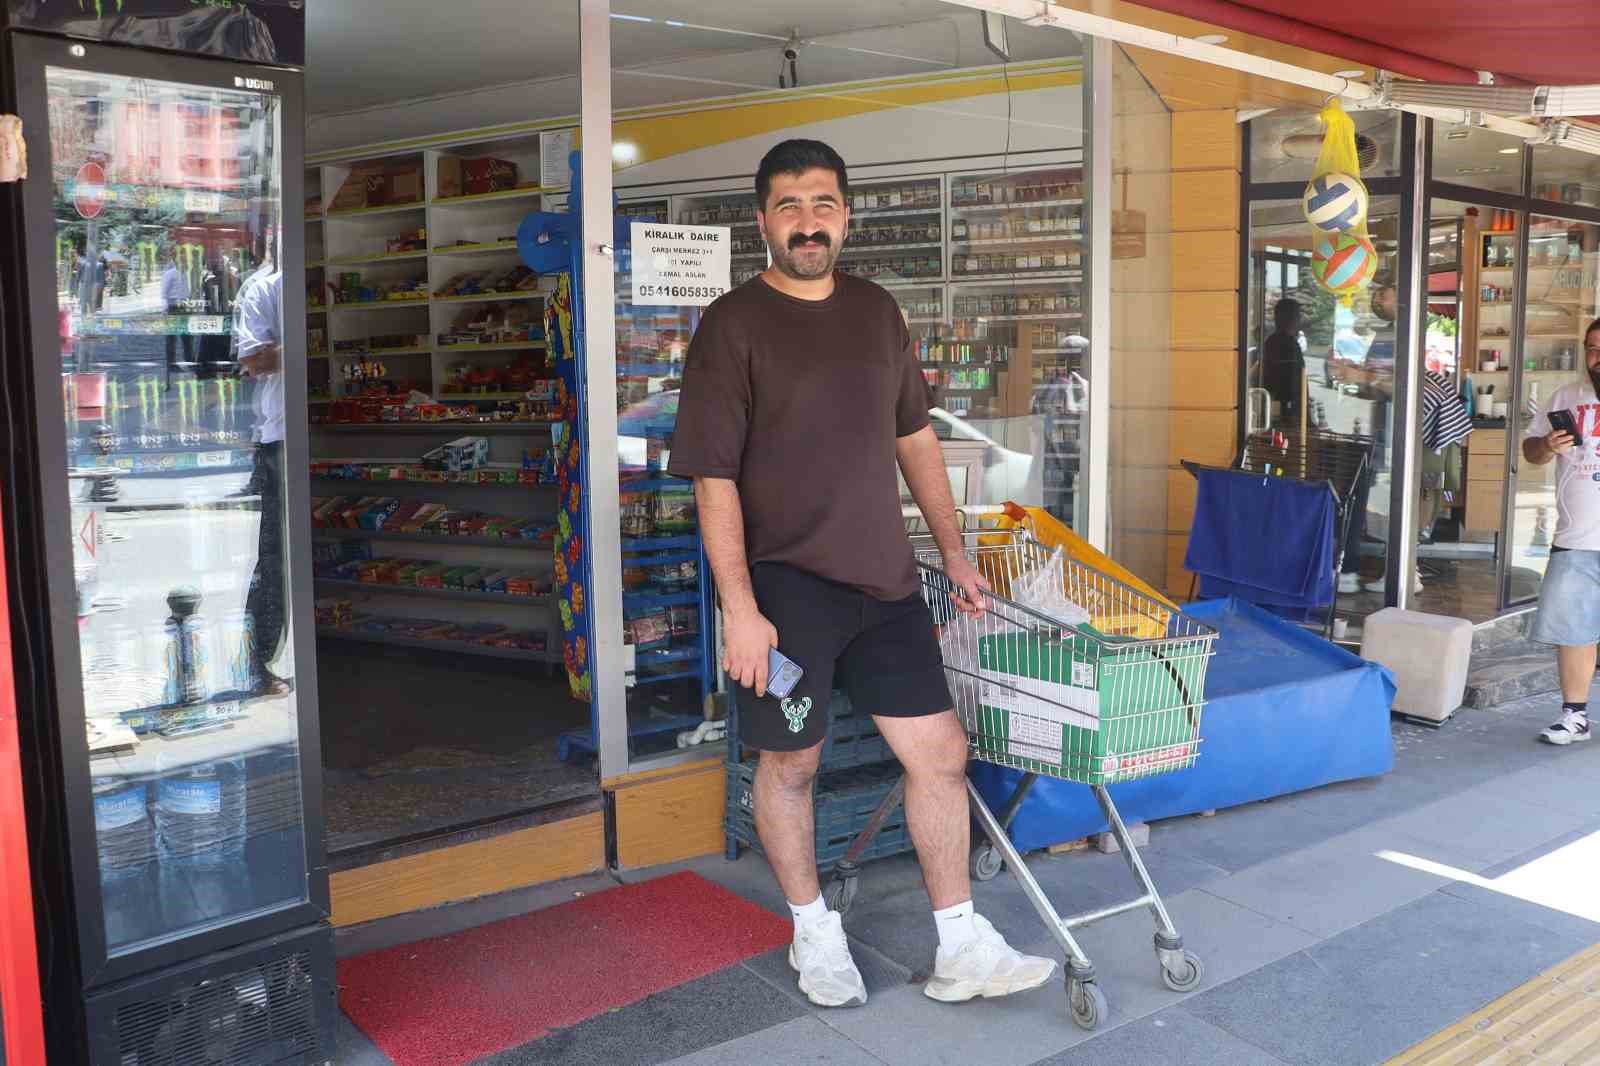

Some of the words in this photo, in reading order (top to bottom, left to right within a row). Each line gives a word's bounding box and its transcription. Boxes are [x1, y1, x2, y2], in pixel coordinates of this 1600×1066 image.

[644, 229, 685, 241] KİRALIK
[690, 231, 720, 242] DAİRE
[673, 247, 700, 255] MERKEZ
[639, 285, 725, 298] 05416058353
